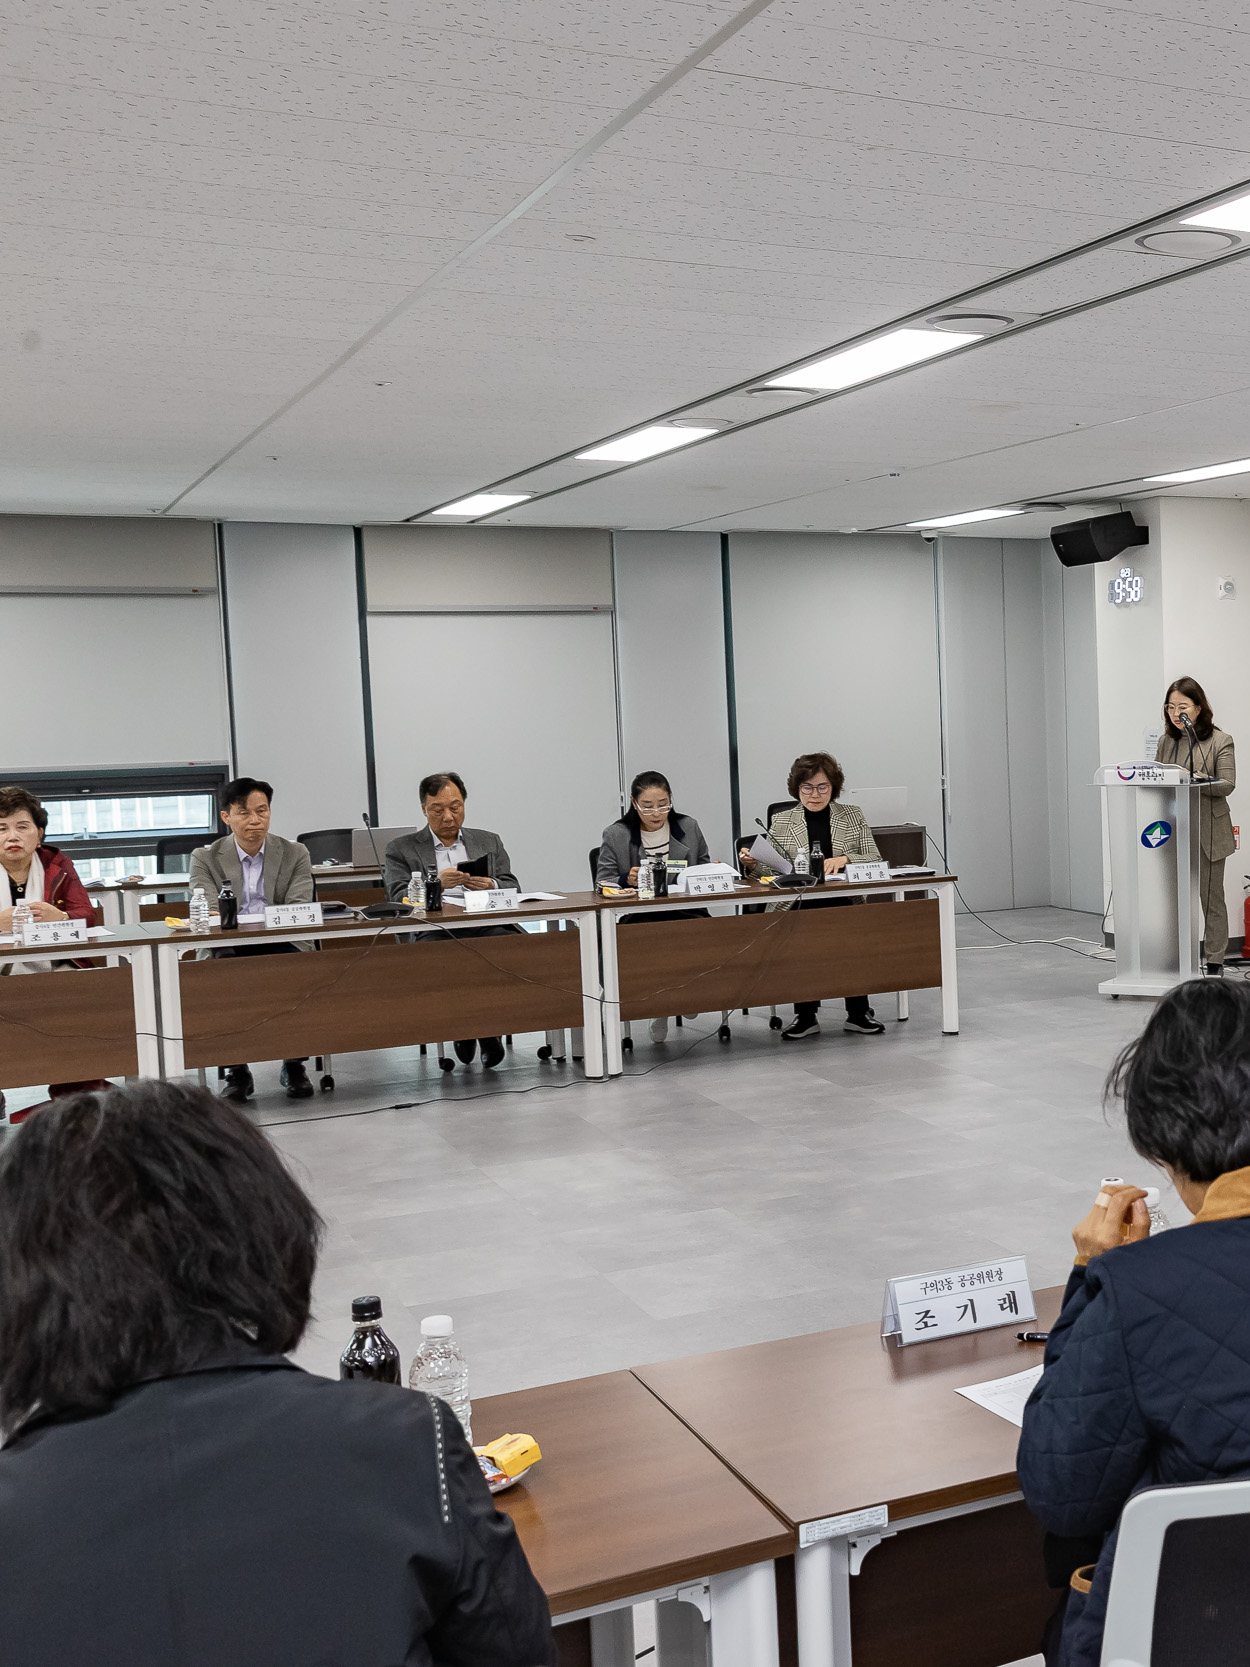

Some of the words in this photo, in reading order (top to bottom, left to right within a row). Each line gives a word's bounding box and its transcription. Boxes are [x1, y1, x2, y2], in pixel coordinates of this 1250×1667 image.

[1114, 576, 1141, 603] 9:58
[919, 1277, 954, 1296] 구의3동
[957, 1267, 1004, 1288] 공공위원장
